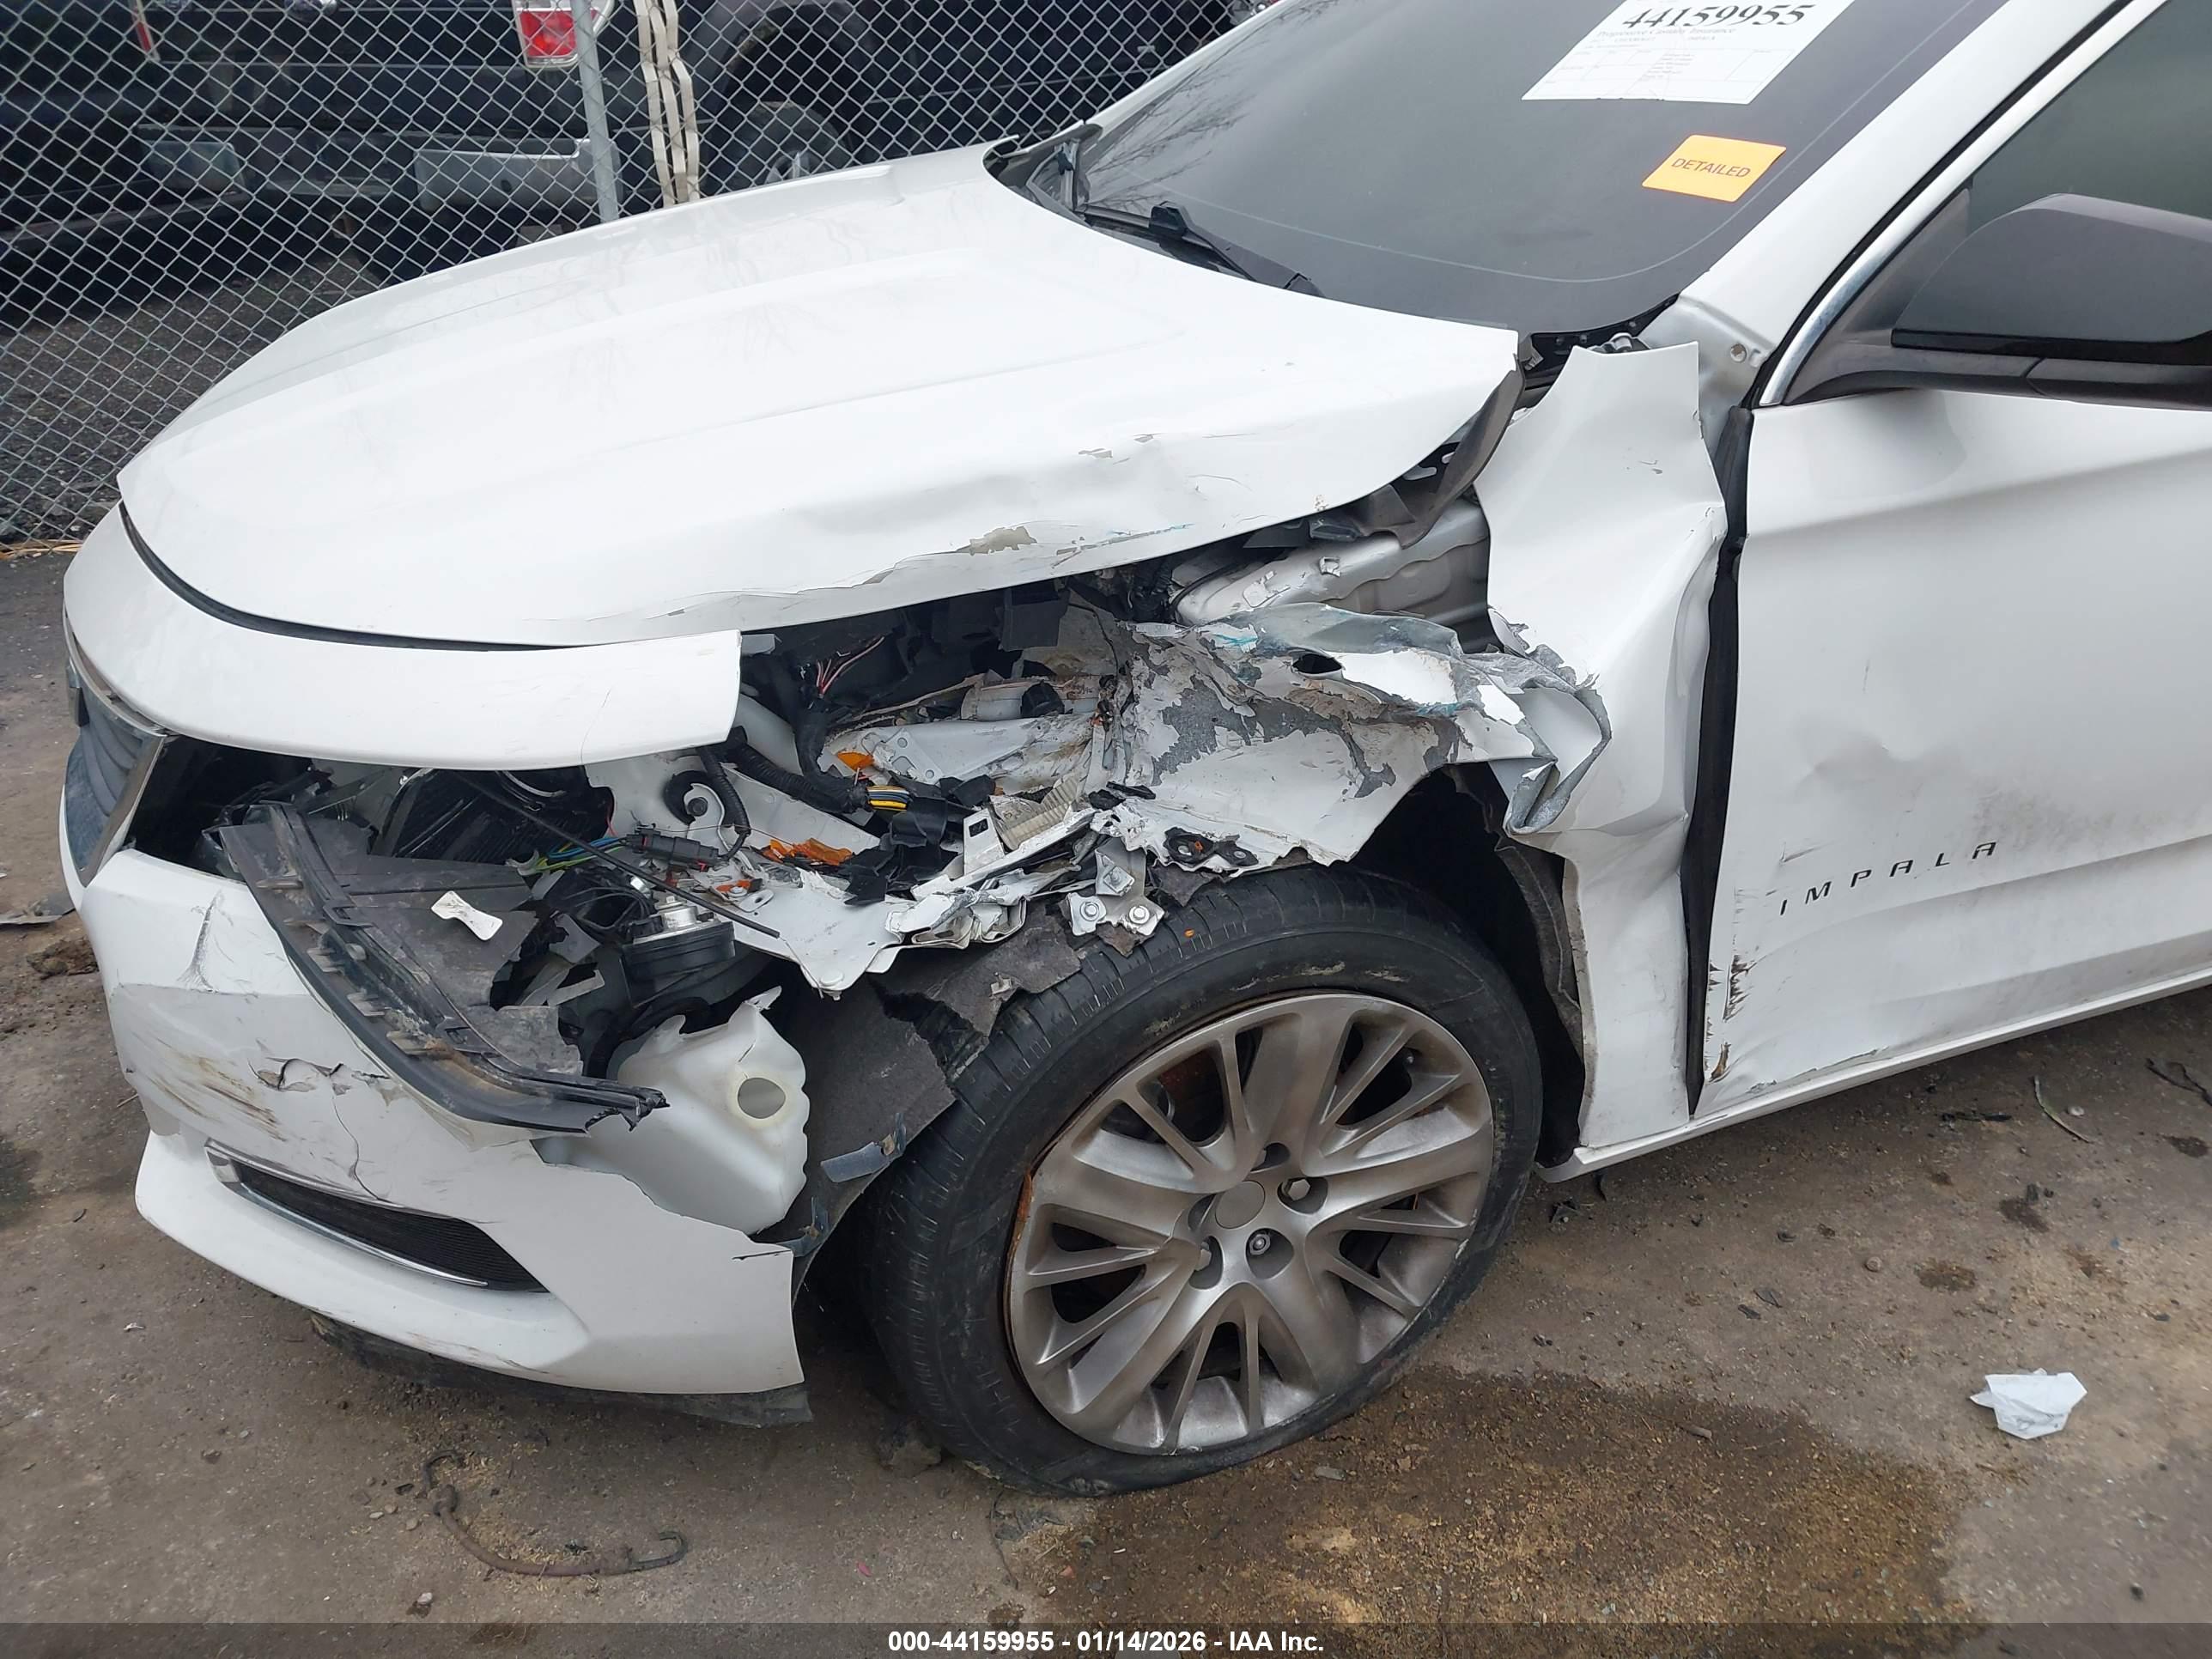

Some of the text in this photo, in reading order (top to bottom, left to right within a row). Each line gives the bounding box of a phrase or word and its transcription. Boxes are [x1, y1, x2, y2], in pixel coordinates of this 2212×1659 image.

[1622, 4, 1816, 28] 44159955
[1671, 157, 1751, 178] DETAILED
[1780, 842, 1996, 915] IMPALA
